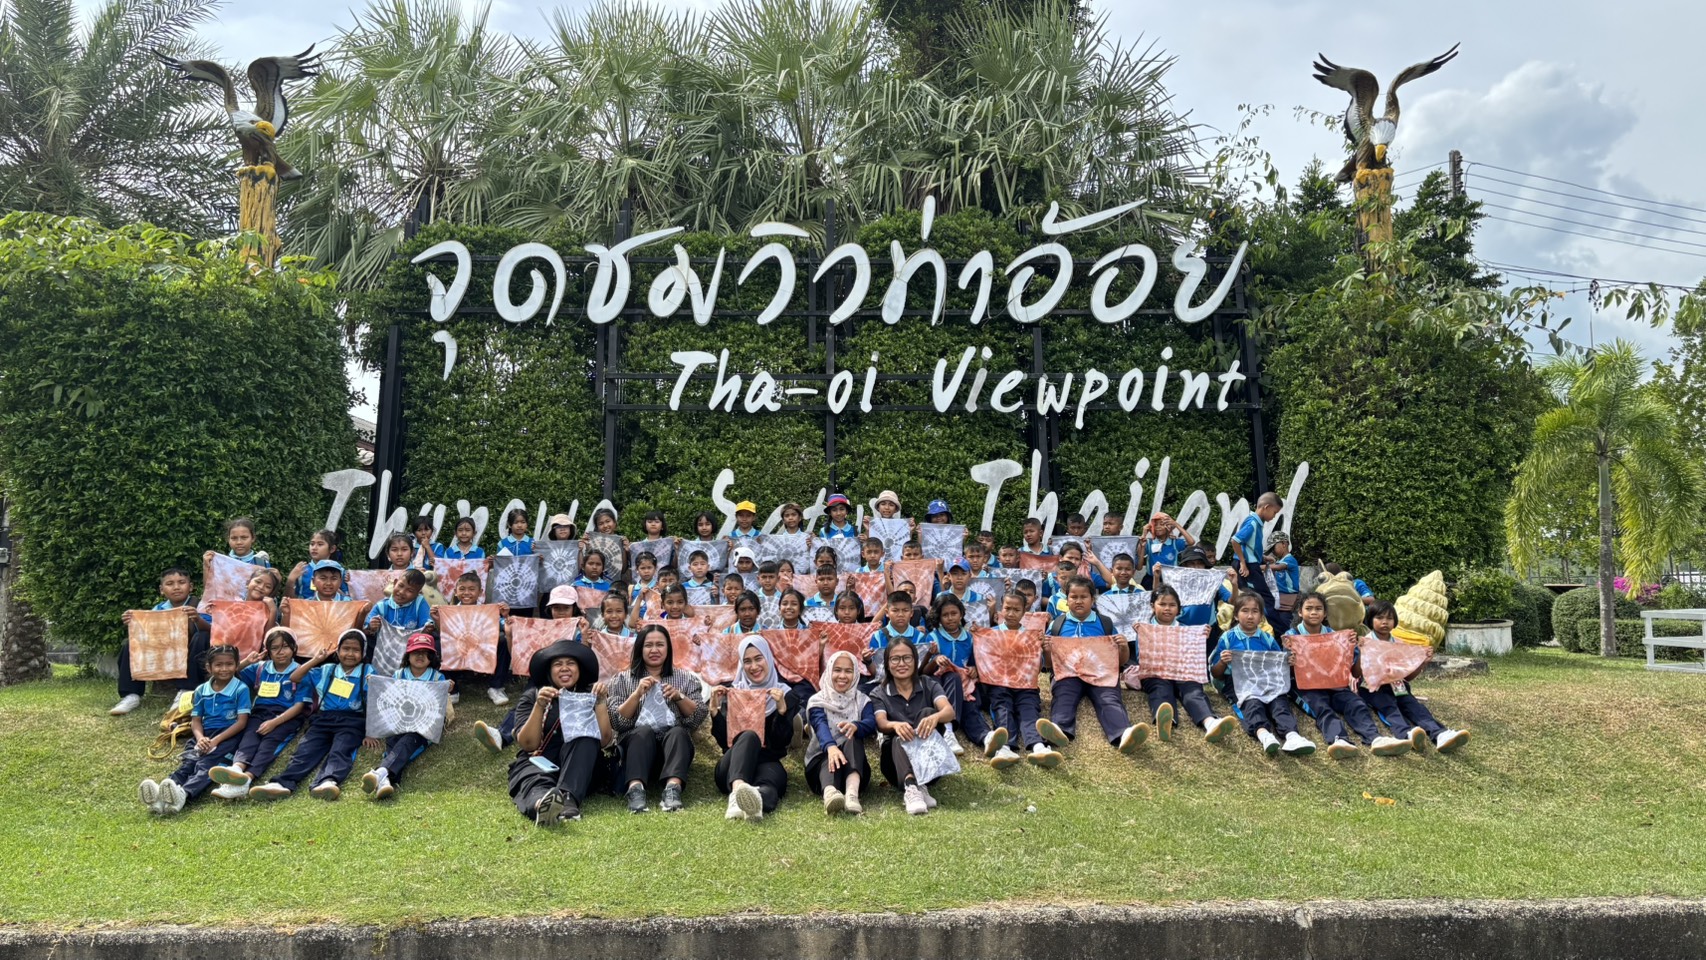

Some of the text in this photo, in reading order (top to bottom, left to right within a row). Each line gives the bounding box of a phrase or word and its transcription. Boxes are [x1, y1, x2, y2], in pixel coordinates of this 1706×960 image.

[411, 195, 1247, 381] จุดชมวิวท่าอ้อย
[669, 346, 1246, 430] Tha-oi Viewpoint
